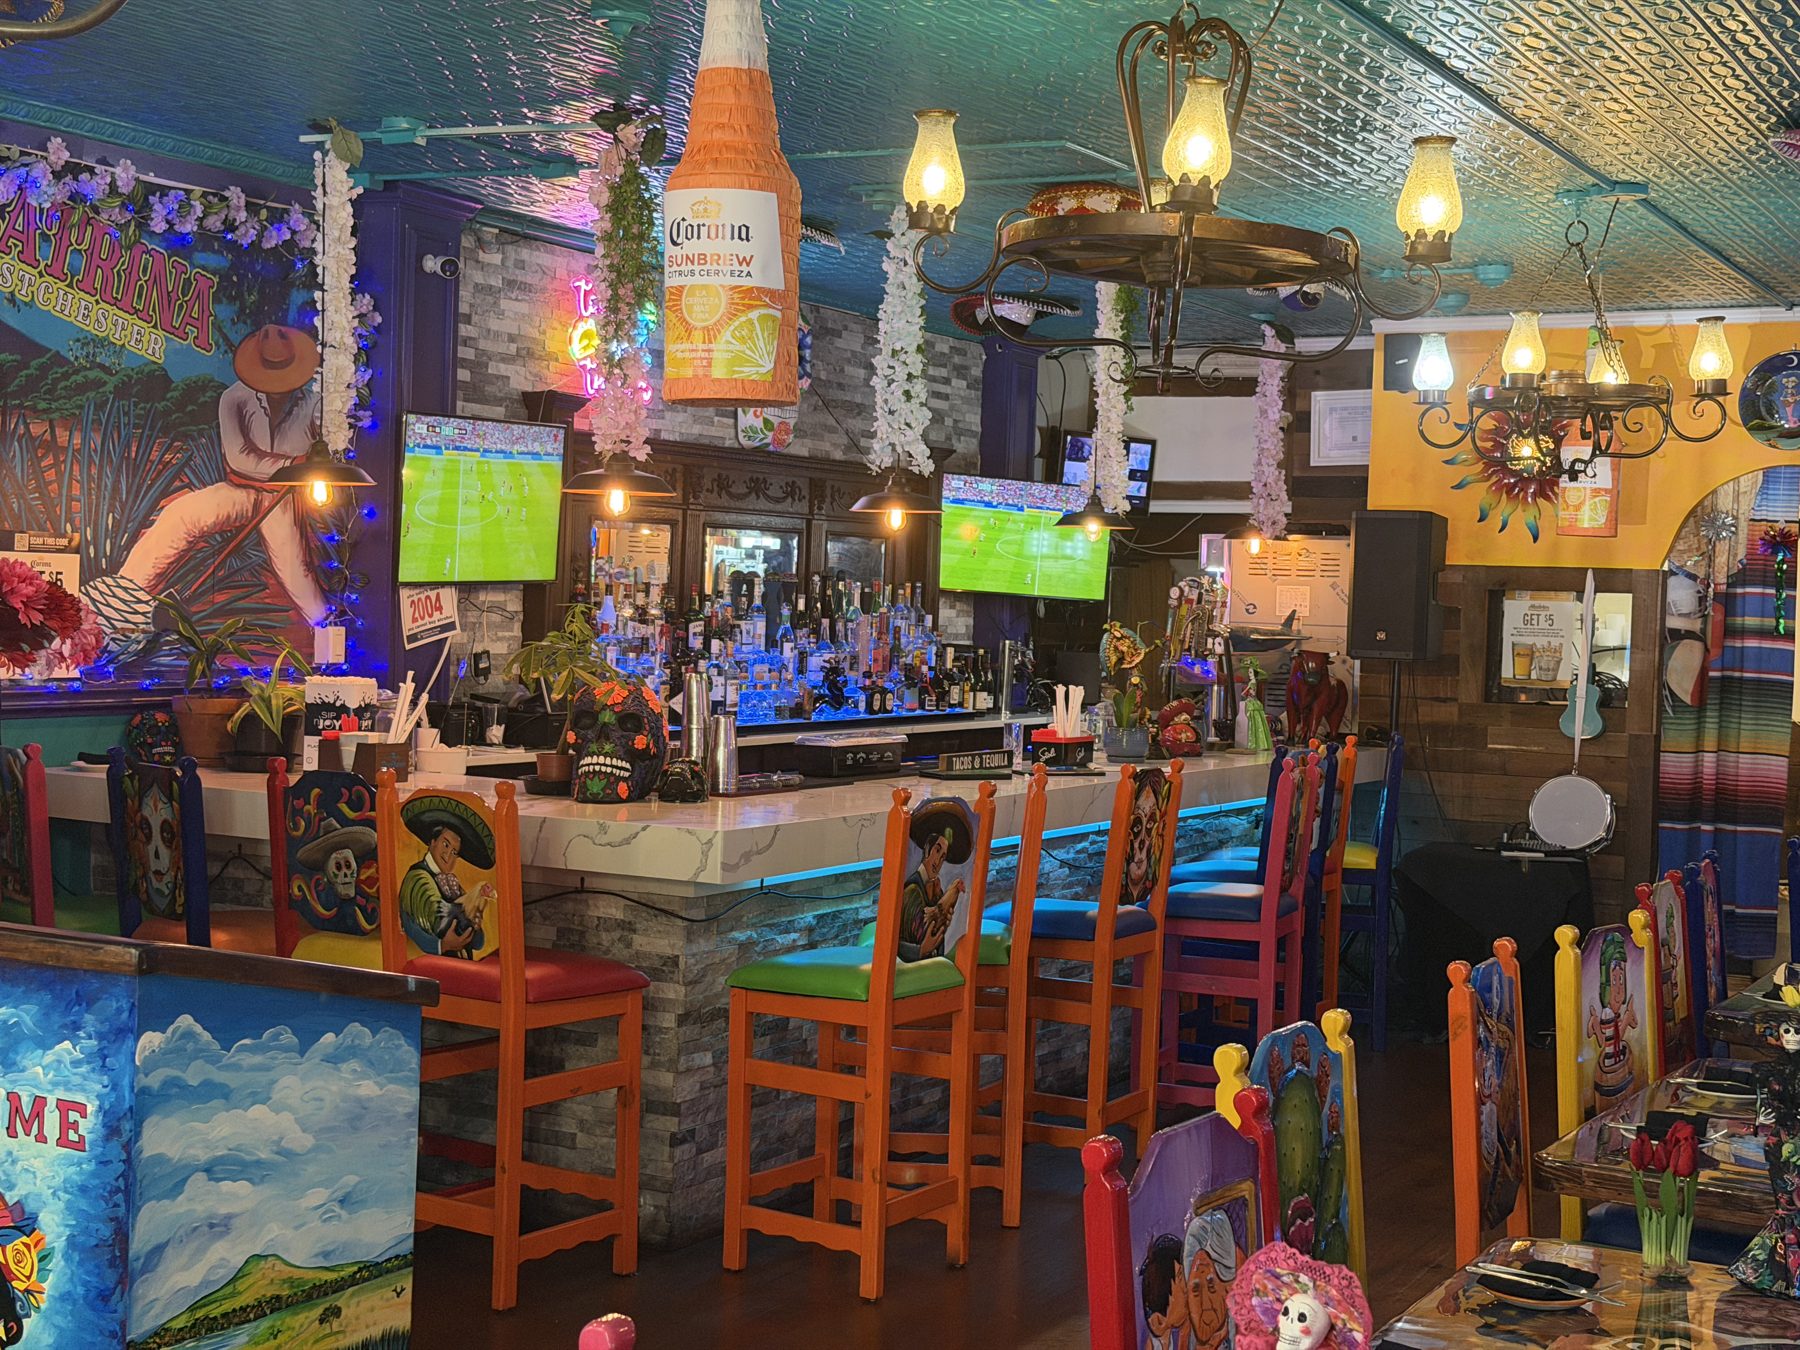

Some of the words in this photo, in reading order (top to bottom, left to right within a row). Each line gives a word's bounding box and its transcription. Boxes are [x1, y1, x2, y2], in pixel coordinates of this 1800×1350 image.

[669, 216, 753, 250] Corona
[668, 252, 754, 268] SUNBREW
[668, 269, 696, 279] CITRUS
[698, 268, 753, 279] CERVEZA
[29, 536, 43, 545] SCAN
[44, 537, 55, 545] THIS
[56, 538, 69, 546] CODE
[410, 591, 443, 625] 2004
[1523, 613, 1541, 627] GET
[1544, 613, 1555, 628] $5
[320, 711, 337, 719] SIP
[952, 756, 972, 770] TACOS
[973, 755, 981, 768] &
[982, 752, 1009, 767] TEQUILA
[6, 1091, 88, 1152] ME
